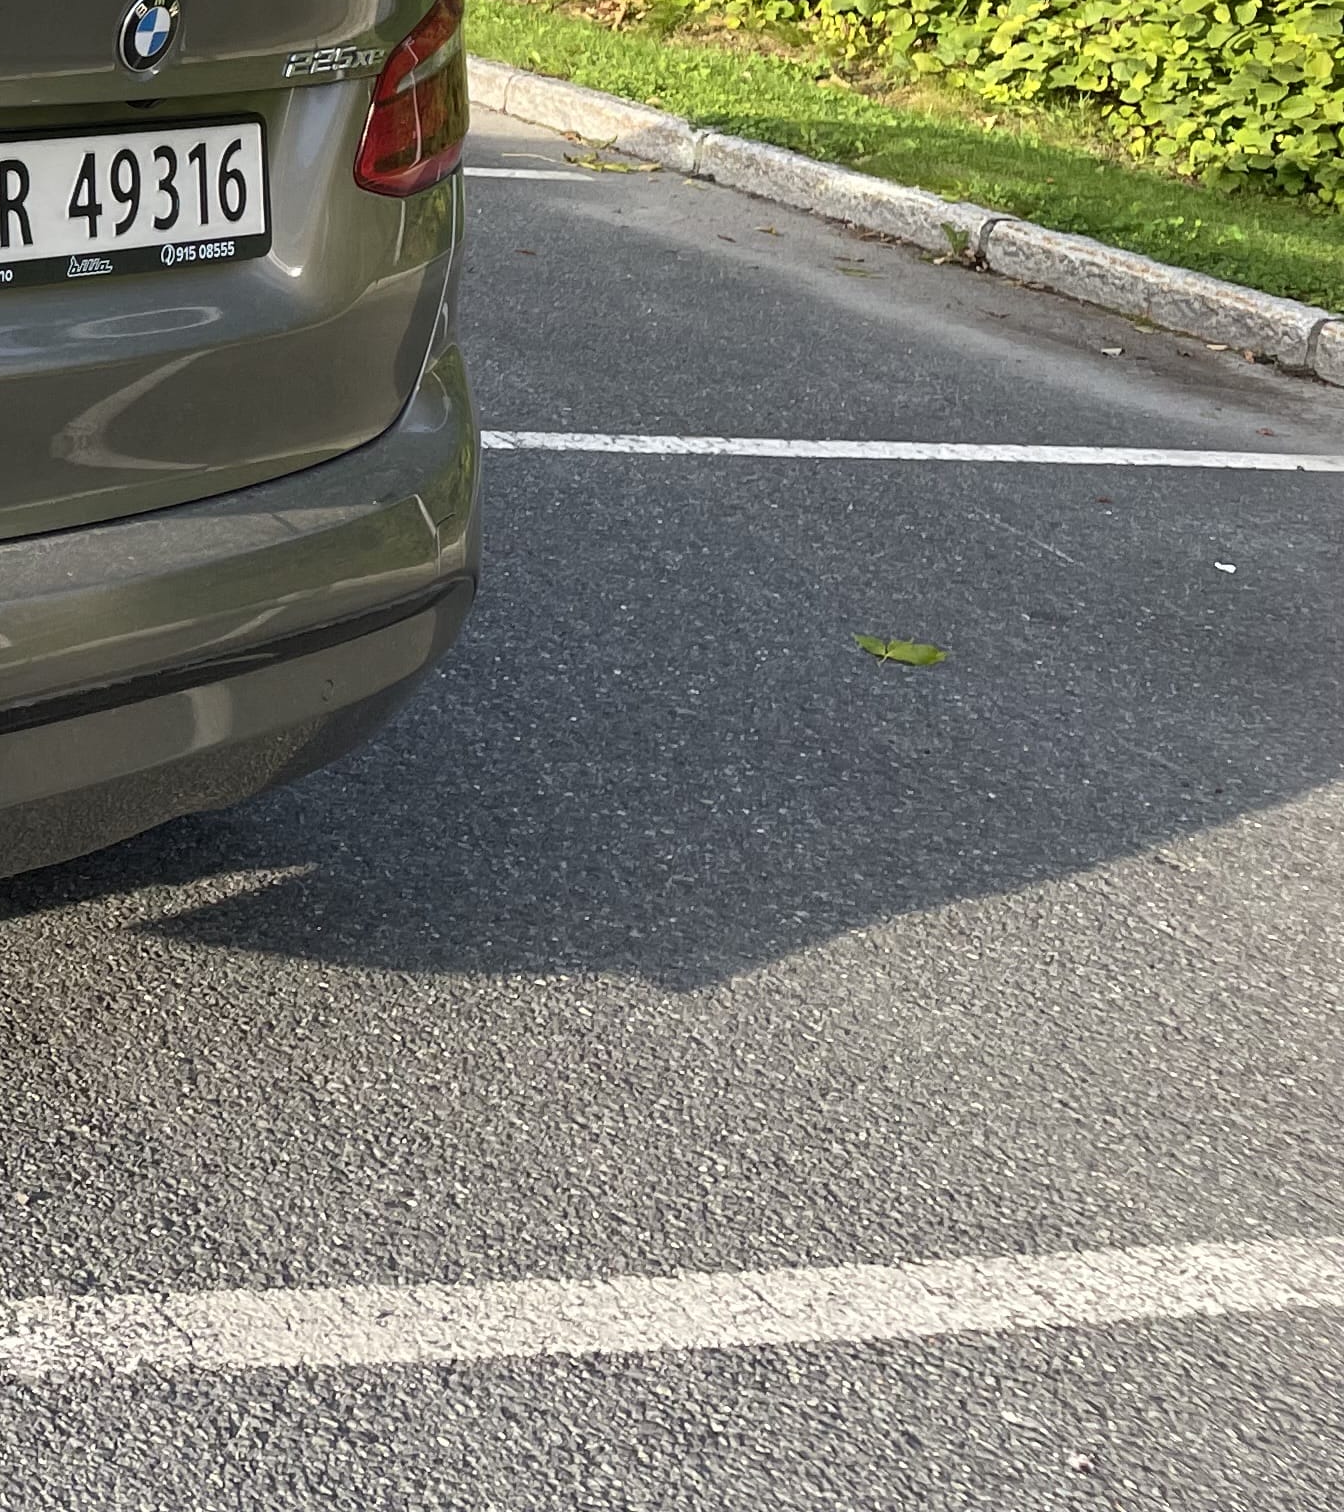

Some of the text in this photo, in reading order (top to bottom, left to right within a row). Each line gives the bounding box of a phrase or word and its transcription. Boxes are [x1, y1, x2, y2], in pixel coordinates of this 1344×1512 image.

[67, 138, 248, 239] 49316
[175, 240, 235, 262] 915 08555
